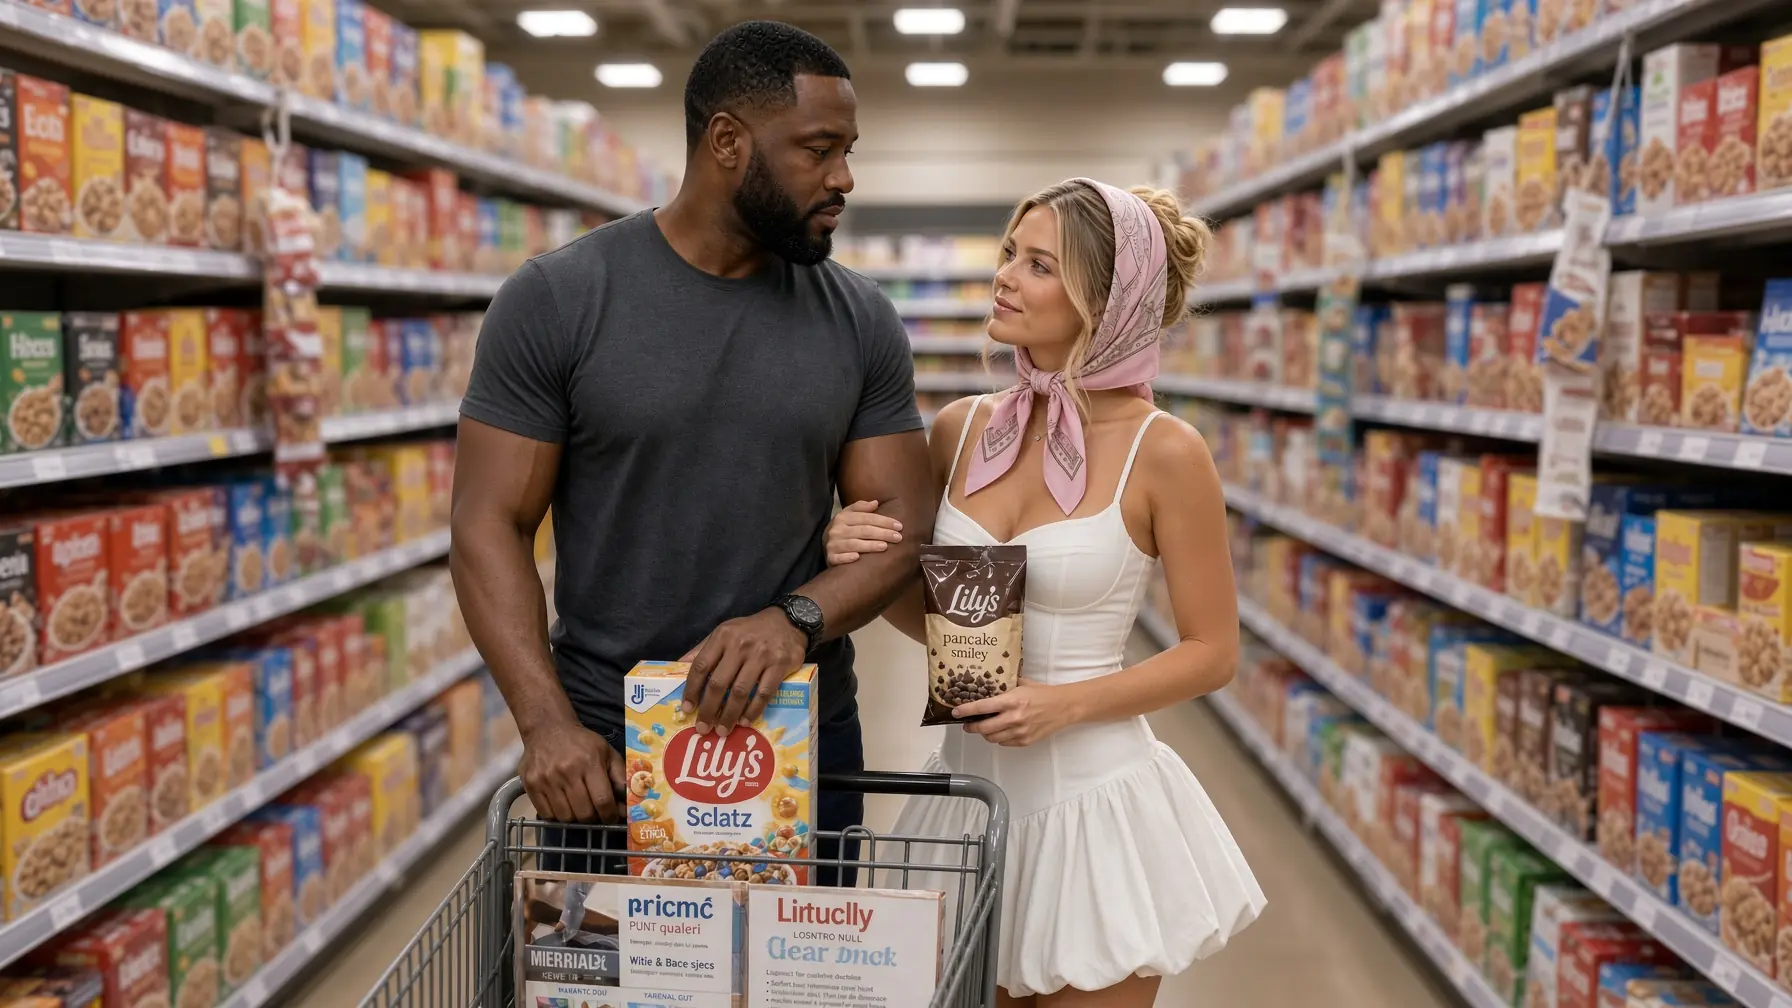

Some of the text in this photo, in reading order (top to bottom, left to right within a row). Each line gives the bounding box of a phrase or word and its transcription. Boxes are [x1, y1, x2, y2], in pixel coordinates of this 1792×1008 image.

[946, 584, 1000, 623] Lily's
[943, 632, 998, 646] pancake
[951, 648, 988, 662] smiley
[675, 733, 764, 798] Lily's
[686, 806, 752, 828] Sclatz
[777, 898, 874, 932] Lirtuclly
[629, 921, 701, 936] PUNT qualeri
[793, 932, 863, 943] LOSNTRO NULL
[629, 955, 715, 971] Witie & Bace sjecs
